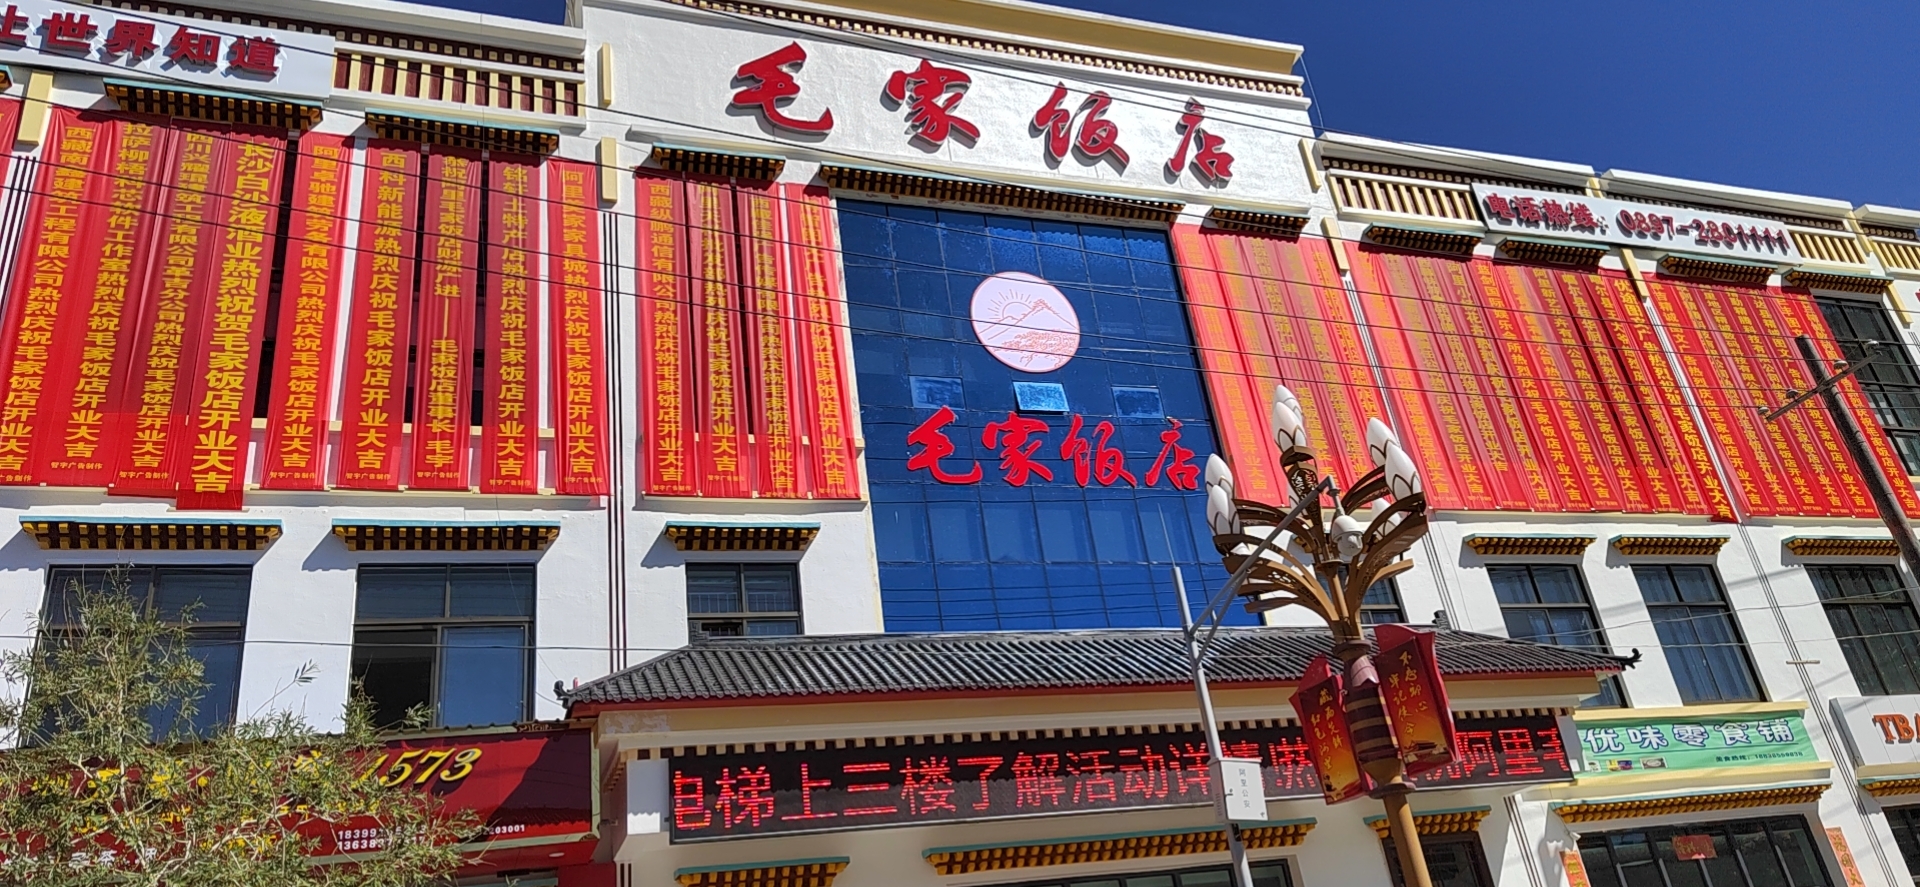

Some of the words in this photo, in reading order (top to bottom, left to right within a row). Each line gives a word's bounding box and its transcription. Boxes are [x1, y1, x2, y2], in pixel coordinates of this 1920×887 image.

[731, 40, 1237, 180] 毛家饭店
[191, 141, 275, 493] 长沙白沙液酒业热烈祝贺毛家饭店开业大吉
[356, 152, 407, 469] 西科新能源热烈庆祝毛家饭店开业大吉
[907, 405, 1200, 491] 毛家饭店
[1388, 672, 1416, 736] 牢记使命
[1399, 650, 1429, 713] 不忘初心
[1584, 718, 1795, 755] 优味零食铺
[1872, 713, 1920, 742] TB
